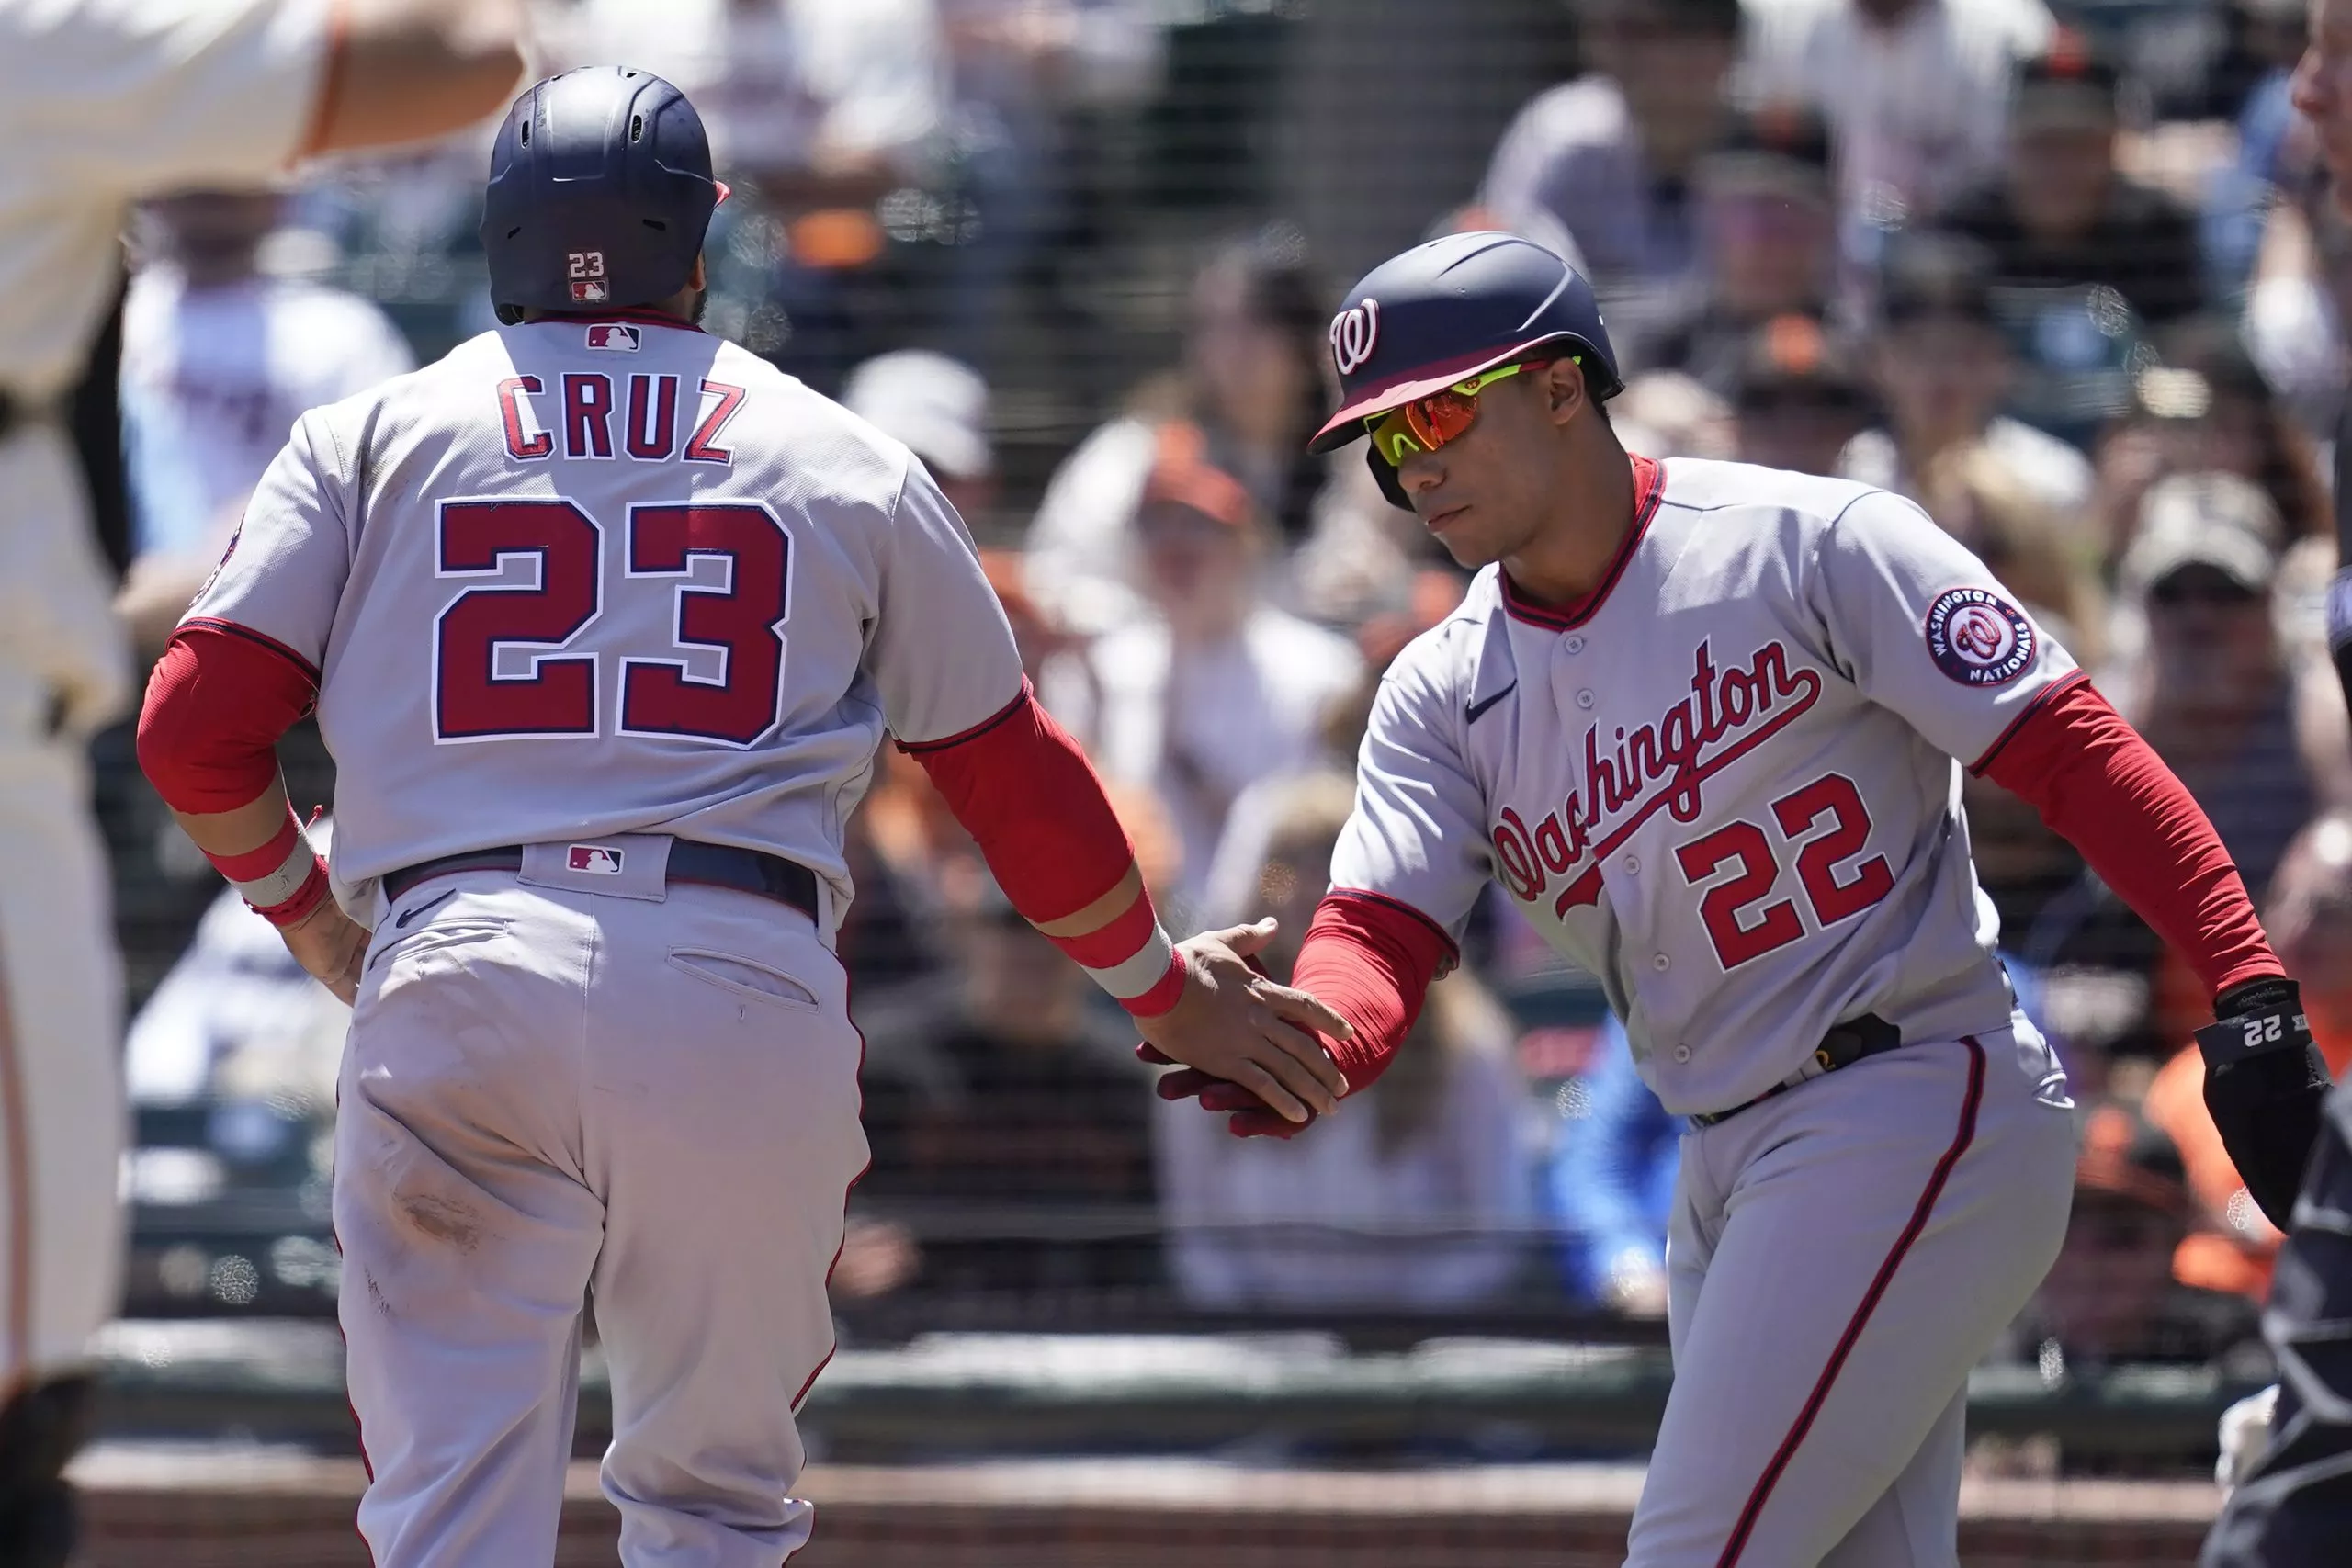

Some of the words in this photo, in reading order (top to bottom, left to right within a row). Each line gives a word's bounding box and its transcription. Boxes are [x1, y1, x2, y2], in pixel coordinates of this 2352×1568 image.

[568, 251, 605, 278] 23
[1329, 297, 1380, 375] W
[496, 371, 749, 467] CRUZ
[431, 495, 795, 750] 23
[1930, 590, 1998, 659] WASHINGTON
[1969, 622, 2032, 682] NATIONALS
[1672, 770, 1898, 974] 22
[2243, 1013, 2283, 1047] 22
